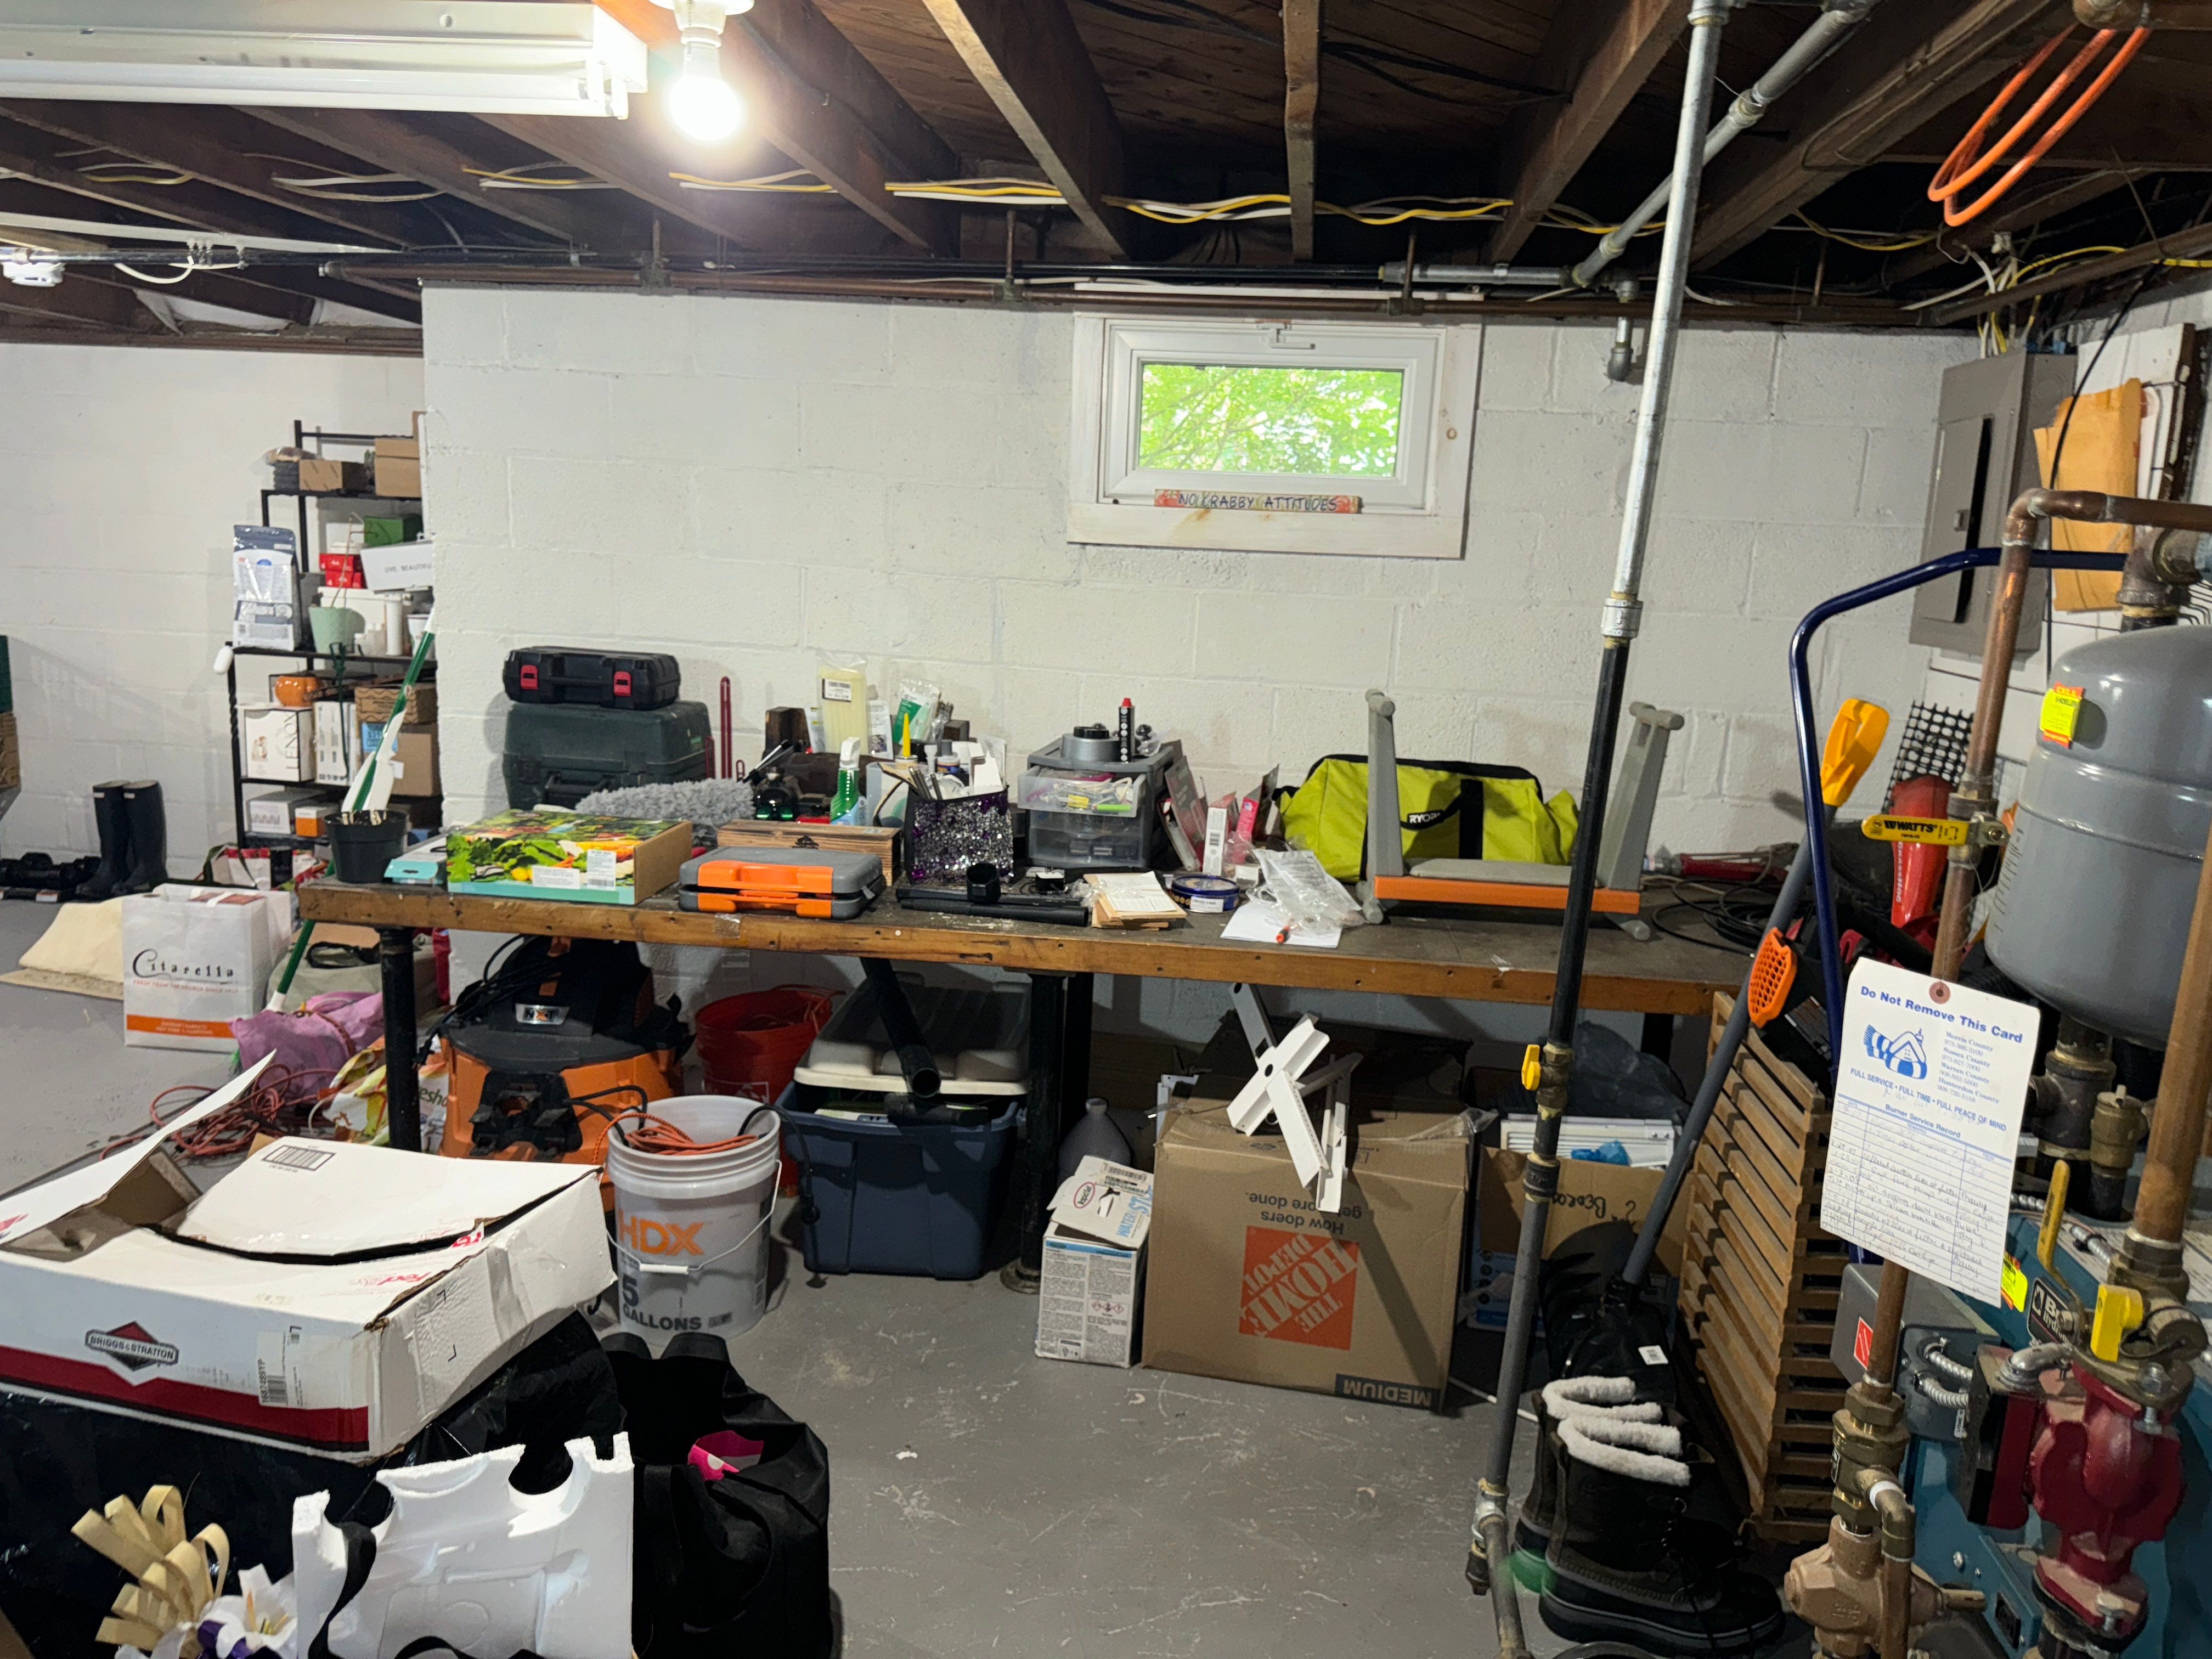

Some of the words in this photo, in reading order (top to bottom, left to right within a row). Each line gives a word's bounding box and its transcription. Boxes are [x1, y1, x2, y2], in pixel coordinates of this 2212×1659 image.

[1179, 495, 1195, 505] NO
[1202, 496, 1254, 509] CRABBY
[1265, 496, 1337, 511] ATTITUDES
[1897, 821, 1935, 833] WATTS
[133, 948, 234, 978] Citarella
[524, 1007, 560, 1022] NXT
[1860, 986, 1876, 998] Do
[1880, 991, 1901, 1006] Not
[1905, 998, 1955, 1022] Remove
[1960, 1015, 1987, 1032] This
[1991, 1025, 2023, 1043] Card
[1968, 1039, 1993, 1052] County
[1941, 1062, 1963, 1075] Warren
[1965, 1071, 1989, 1084] County
[1966, 1055, 1990, 1068] County
[1850, 1068, 1865, 1080] FULL
[1867, 1074, 1893, 1090] SERVICE
[1899, 1085, 1914, 1097] FULL
[1916, 1091, 1931, 1103] TIME
[1936, 1099, 1952, 1111] FULL
[1954, 1105, 1976, 1120] PEACE
[1978, 1114, 1988, 1124] OF
[1989, 1118, 2007, 1132] MIND
[1939, 1077, 1973, 1094] Hunterdon
[1975, 1091, 2000, 1104] County
[1885, 1104, 1908, 1118] Burner
[1909, 1113, 1934, 1128] Service
[1936, 1123, 1961, 1139] Record
[1245, 1192, 1288, 1207] done.
[1292, 1199, 1317, 1212] ore
[619, 1207, 705, 1256] HDX
[1261, 1211, 1304, 1228] doers
[1310, 1218, 1344, 1234] How
[1244, 1233, 1313, 1296] DEPOT
[623, 1274, 639, 1307] 5
[1240, 1240, 1358, 1336] HOME
[623, 1302, 702, 1331] GALLONS
[1296, 1293, 1343, 1333] THE
[1344, 1379, 1432, 1407] MEDIUM
